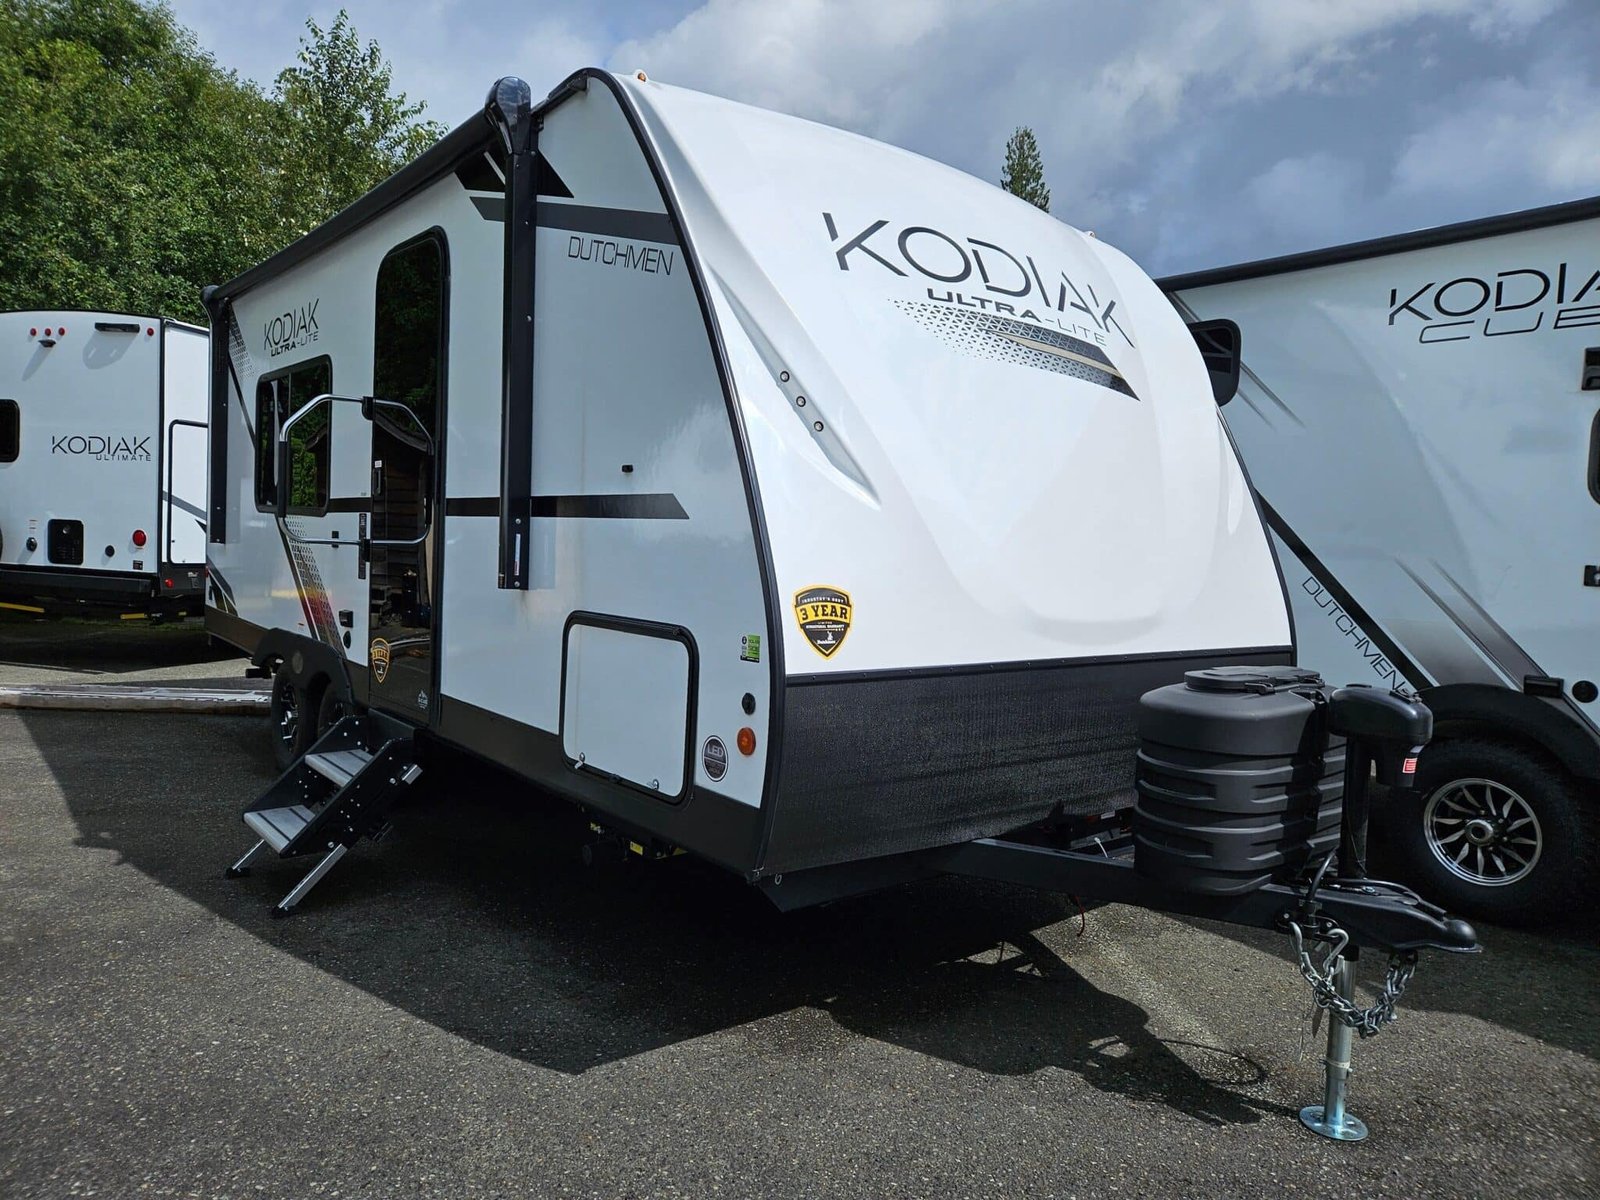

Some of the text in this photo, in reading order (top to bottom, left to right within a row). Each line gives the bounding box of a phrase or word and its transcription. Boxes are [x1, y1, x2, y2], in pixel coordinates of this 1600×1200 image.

[567, 235, 674, 276] DUTCHMEN
[822, 211, 1136, 349] KODIAK
[263, 298, 320, 351] KODIAK
[926, 287, 1107, 347] ULTRA-LITE
[270, 330, 320, 357] ULTRA-LITE
[52, 435, 151, 455] KODIAK
[95, 454, 152, 462] ULTIMATE
[800, 605, 847, 620] 3 YEAR
[1301, 576, 1407, 692] DUTCHMEN
[707, 743, 724, 758] LED
